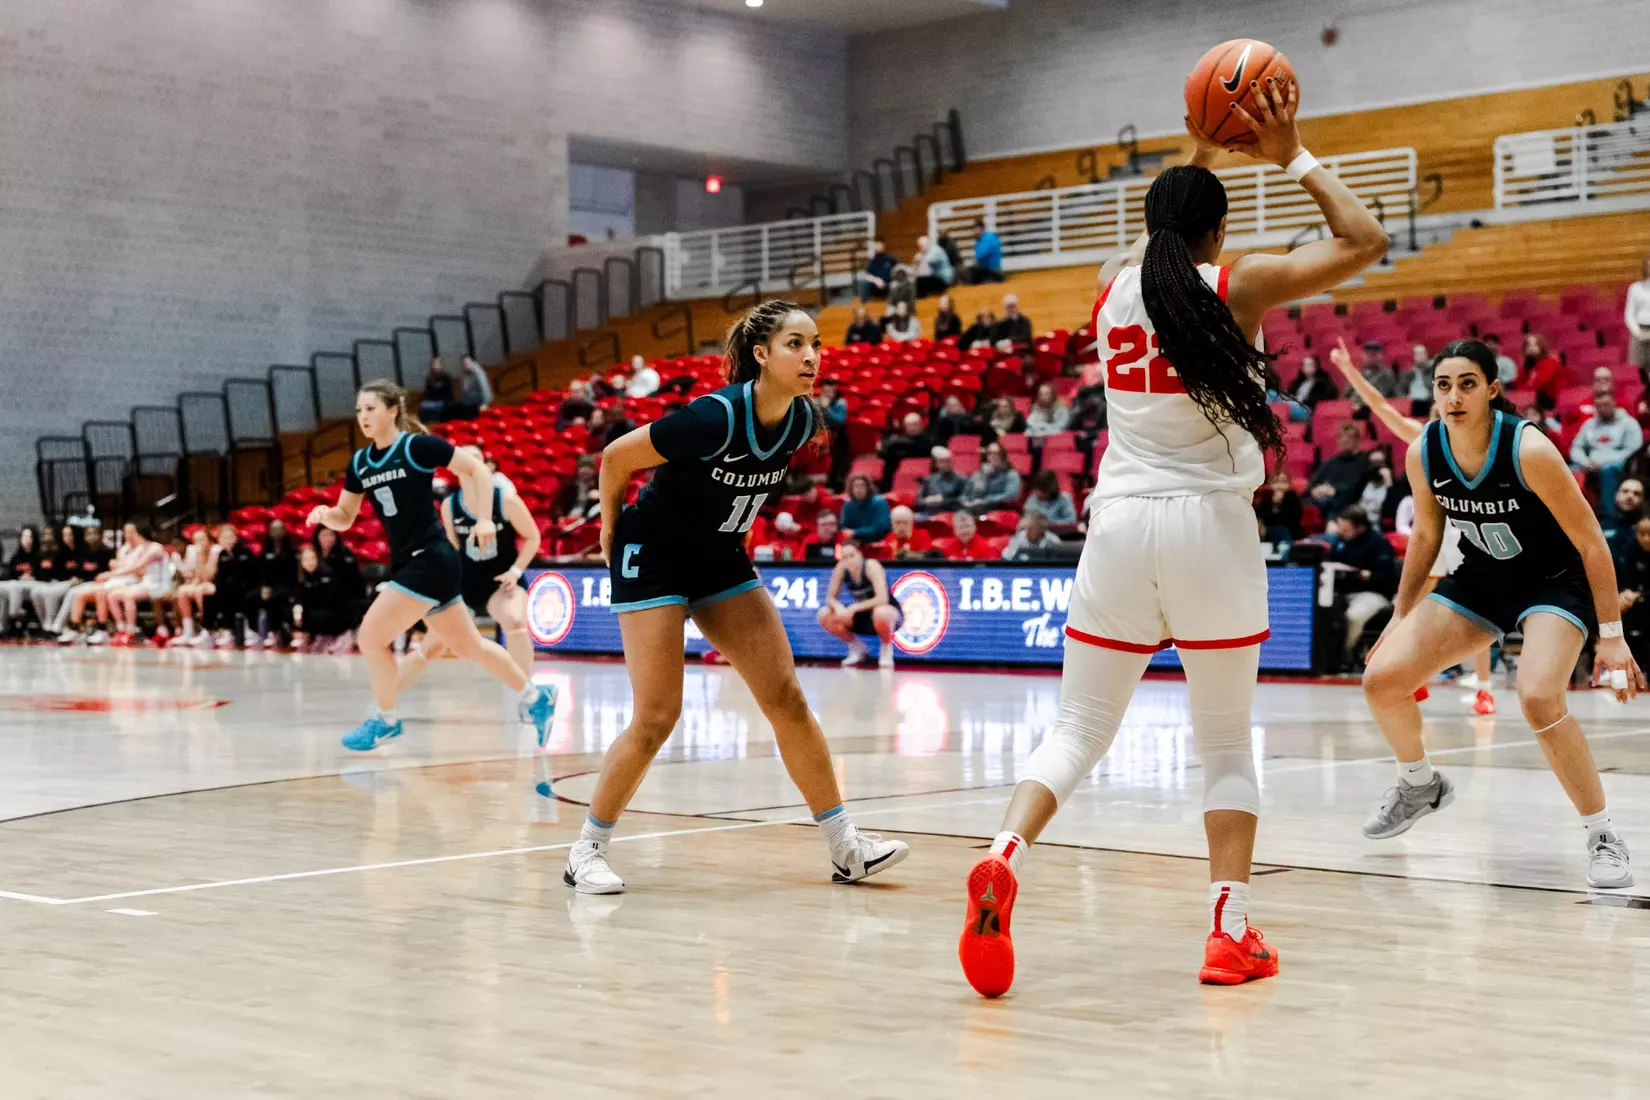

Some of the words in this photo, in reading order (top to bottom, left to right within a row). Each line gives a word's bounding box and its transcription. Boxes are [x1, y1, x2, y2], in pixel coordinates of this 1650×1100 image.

[711, 464, 788, 488] COLUMBI
[718, 492, 769, 533] 11
[621, 543, 643, 579] C
[771, 576, 820, 609] 241
[1022, 612, 1060, 648] The
